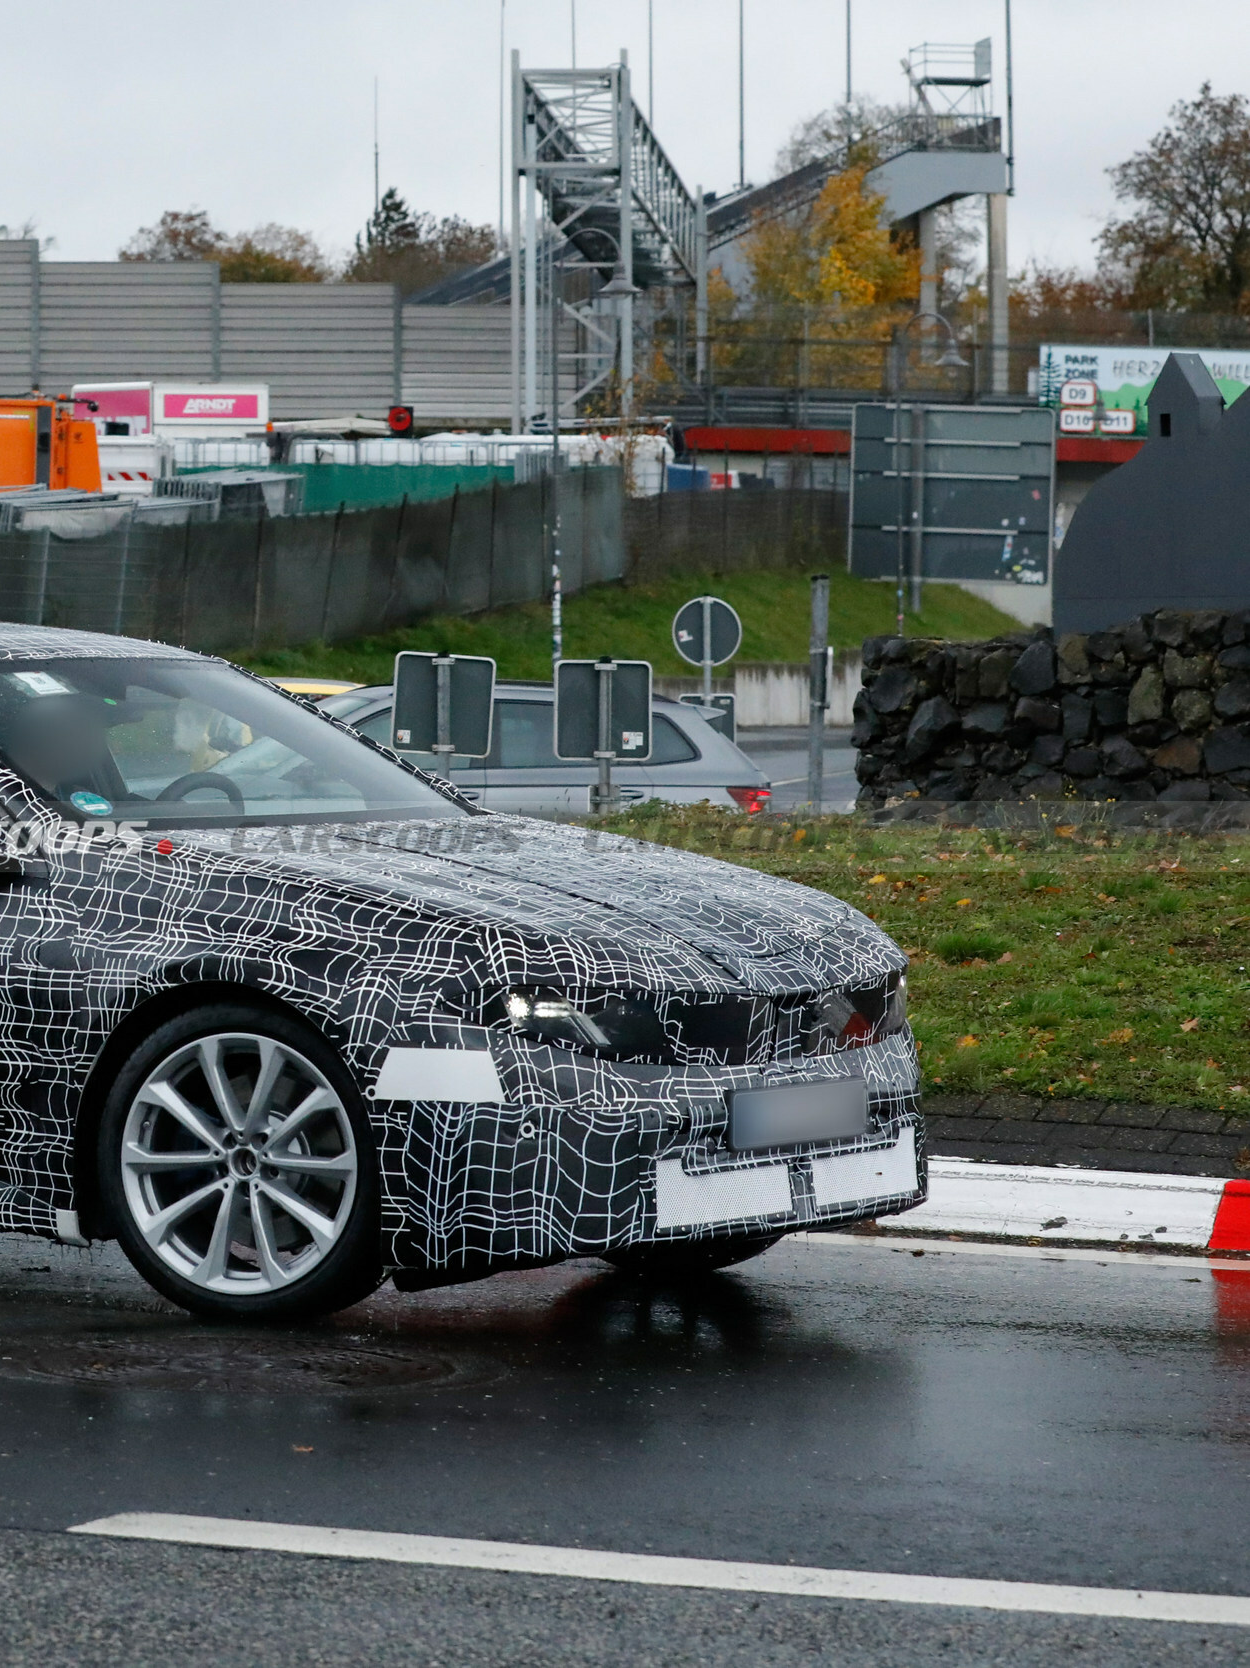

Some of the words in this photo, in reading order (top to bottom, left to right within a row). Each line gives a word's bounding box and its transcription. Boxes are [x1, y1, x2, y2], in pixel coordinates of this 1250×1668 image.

[1064, 354, 1099, 366] PARK
[1064, 368, 1098, 379] ZONE
[1068, 388, 1087, 400] D9
[182, 399, 236, 414] ARNDT
